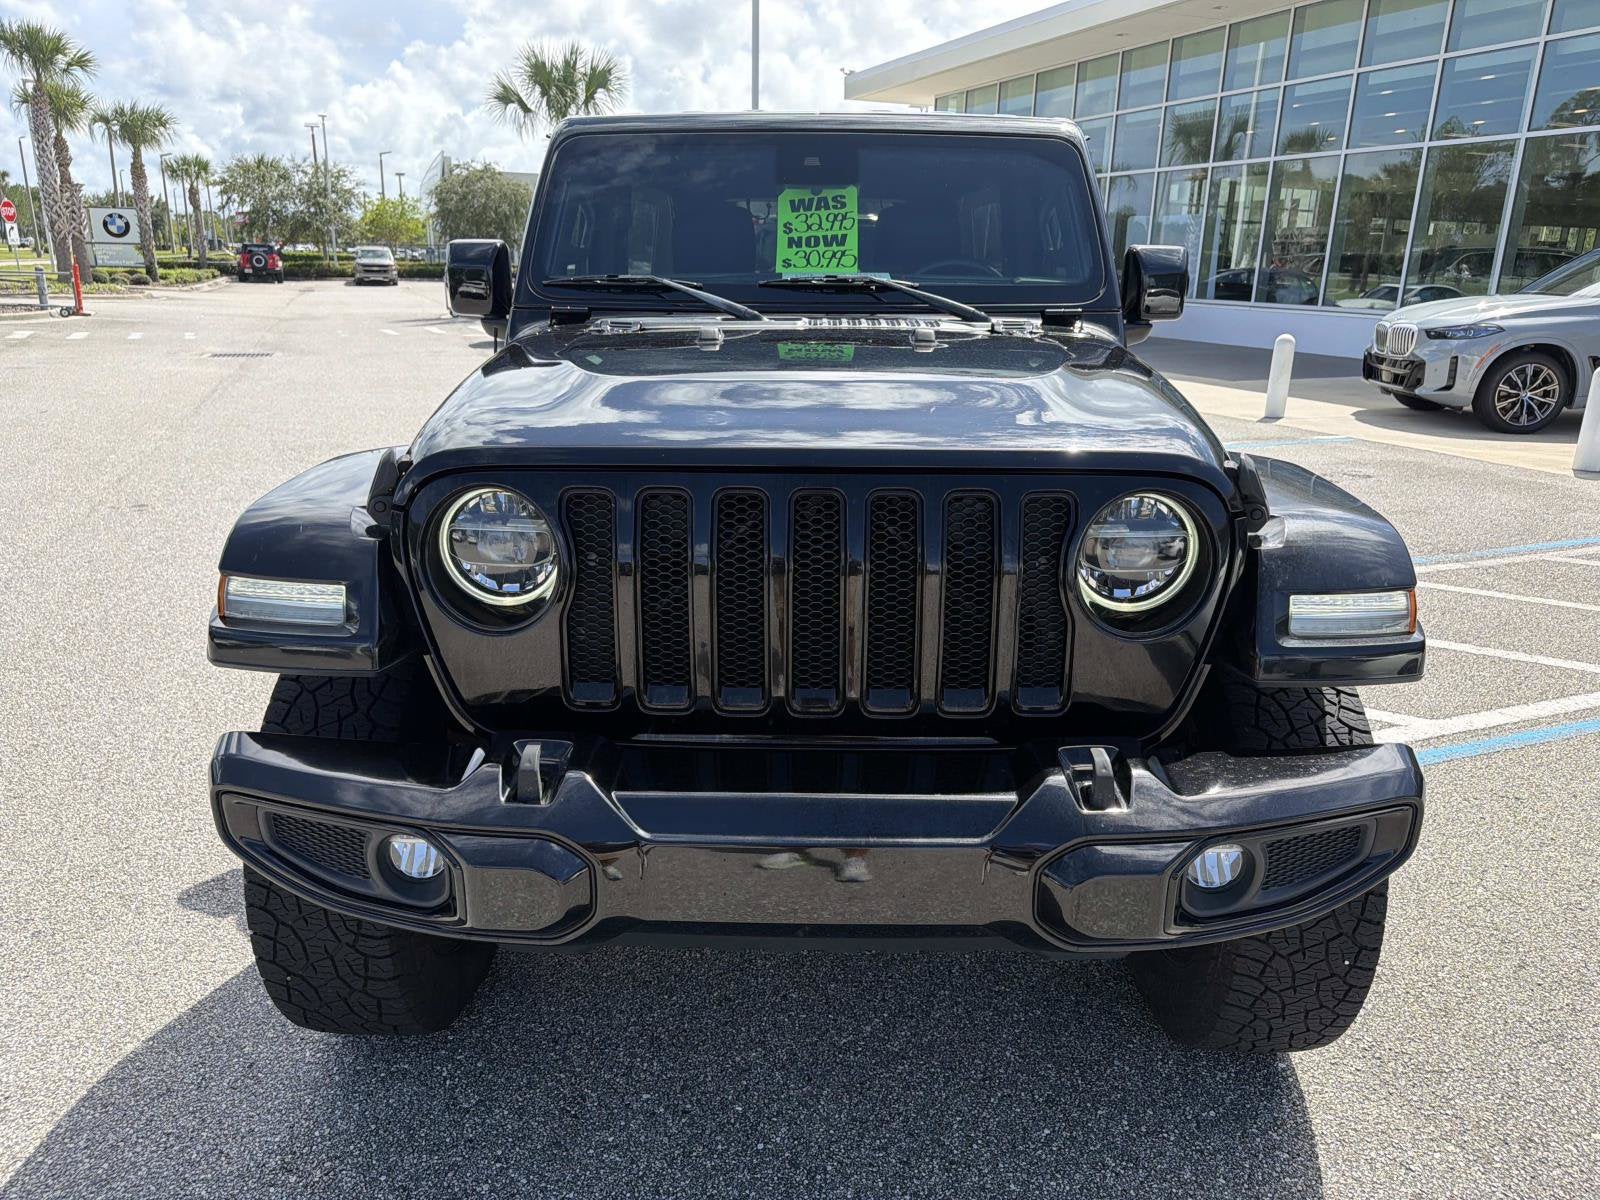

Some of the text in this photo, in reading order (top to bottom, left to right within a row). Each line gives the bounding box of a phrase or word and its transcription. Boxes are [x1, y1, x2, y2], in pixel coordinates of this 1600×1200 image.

[1, 206, 15, 216] STOP
[789, 195, 847, 213] WAS
[787, 234, 848, 249] NOW
